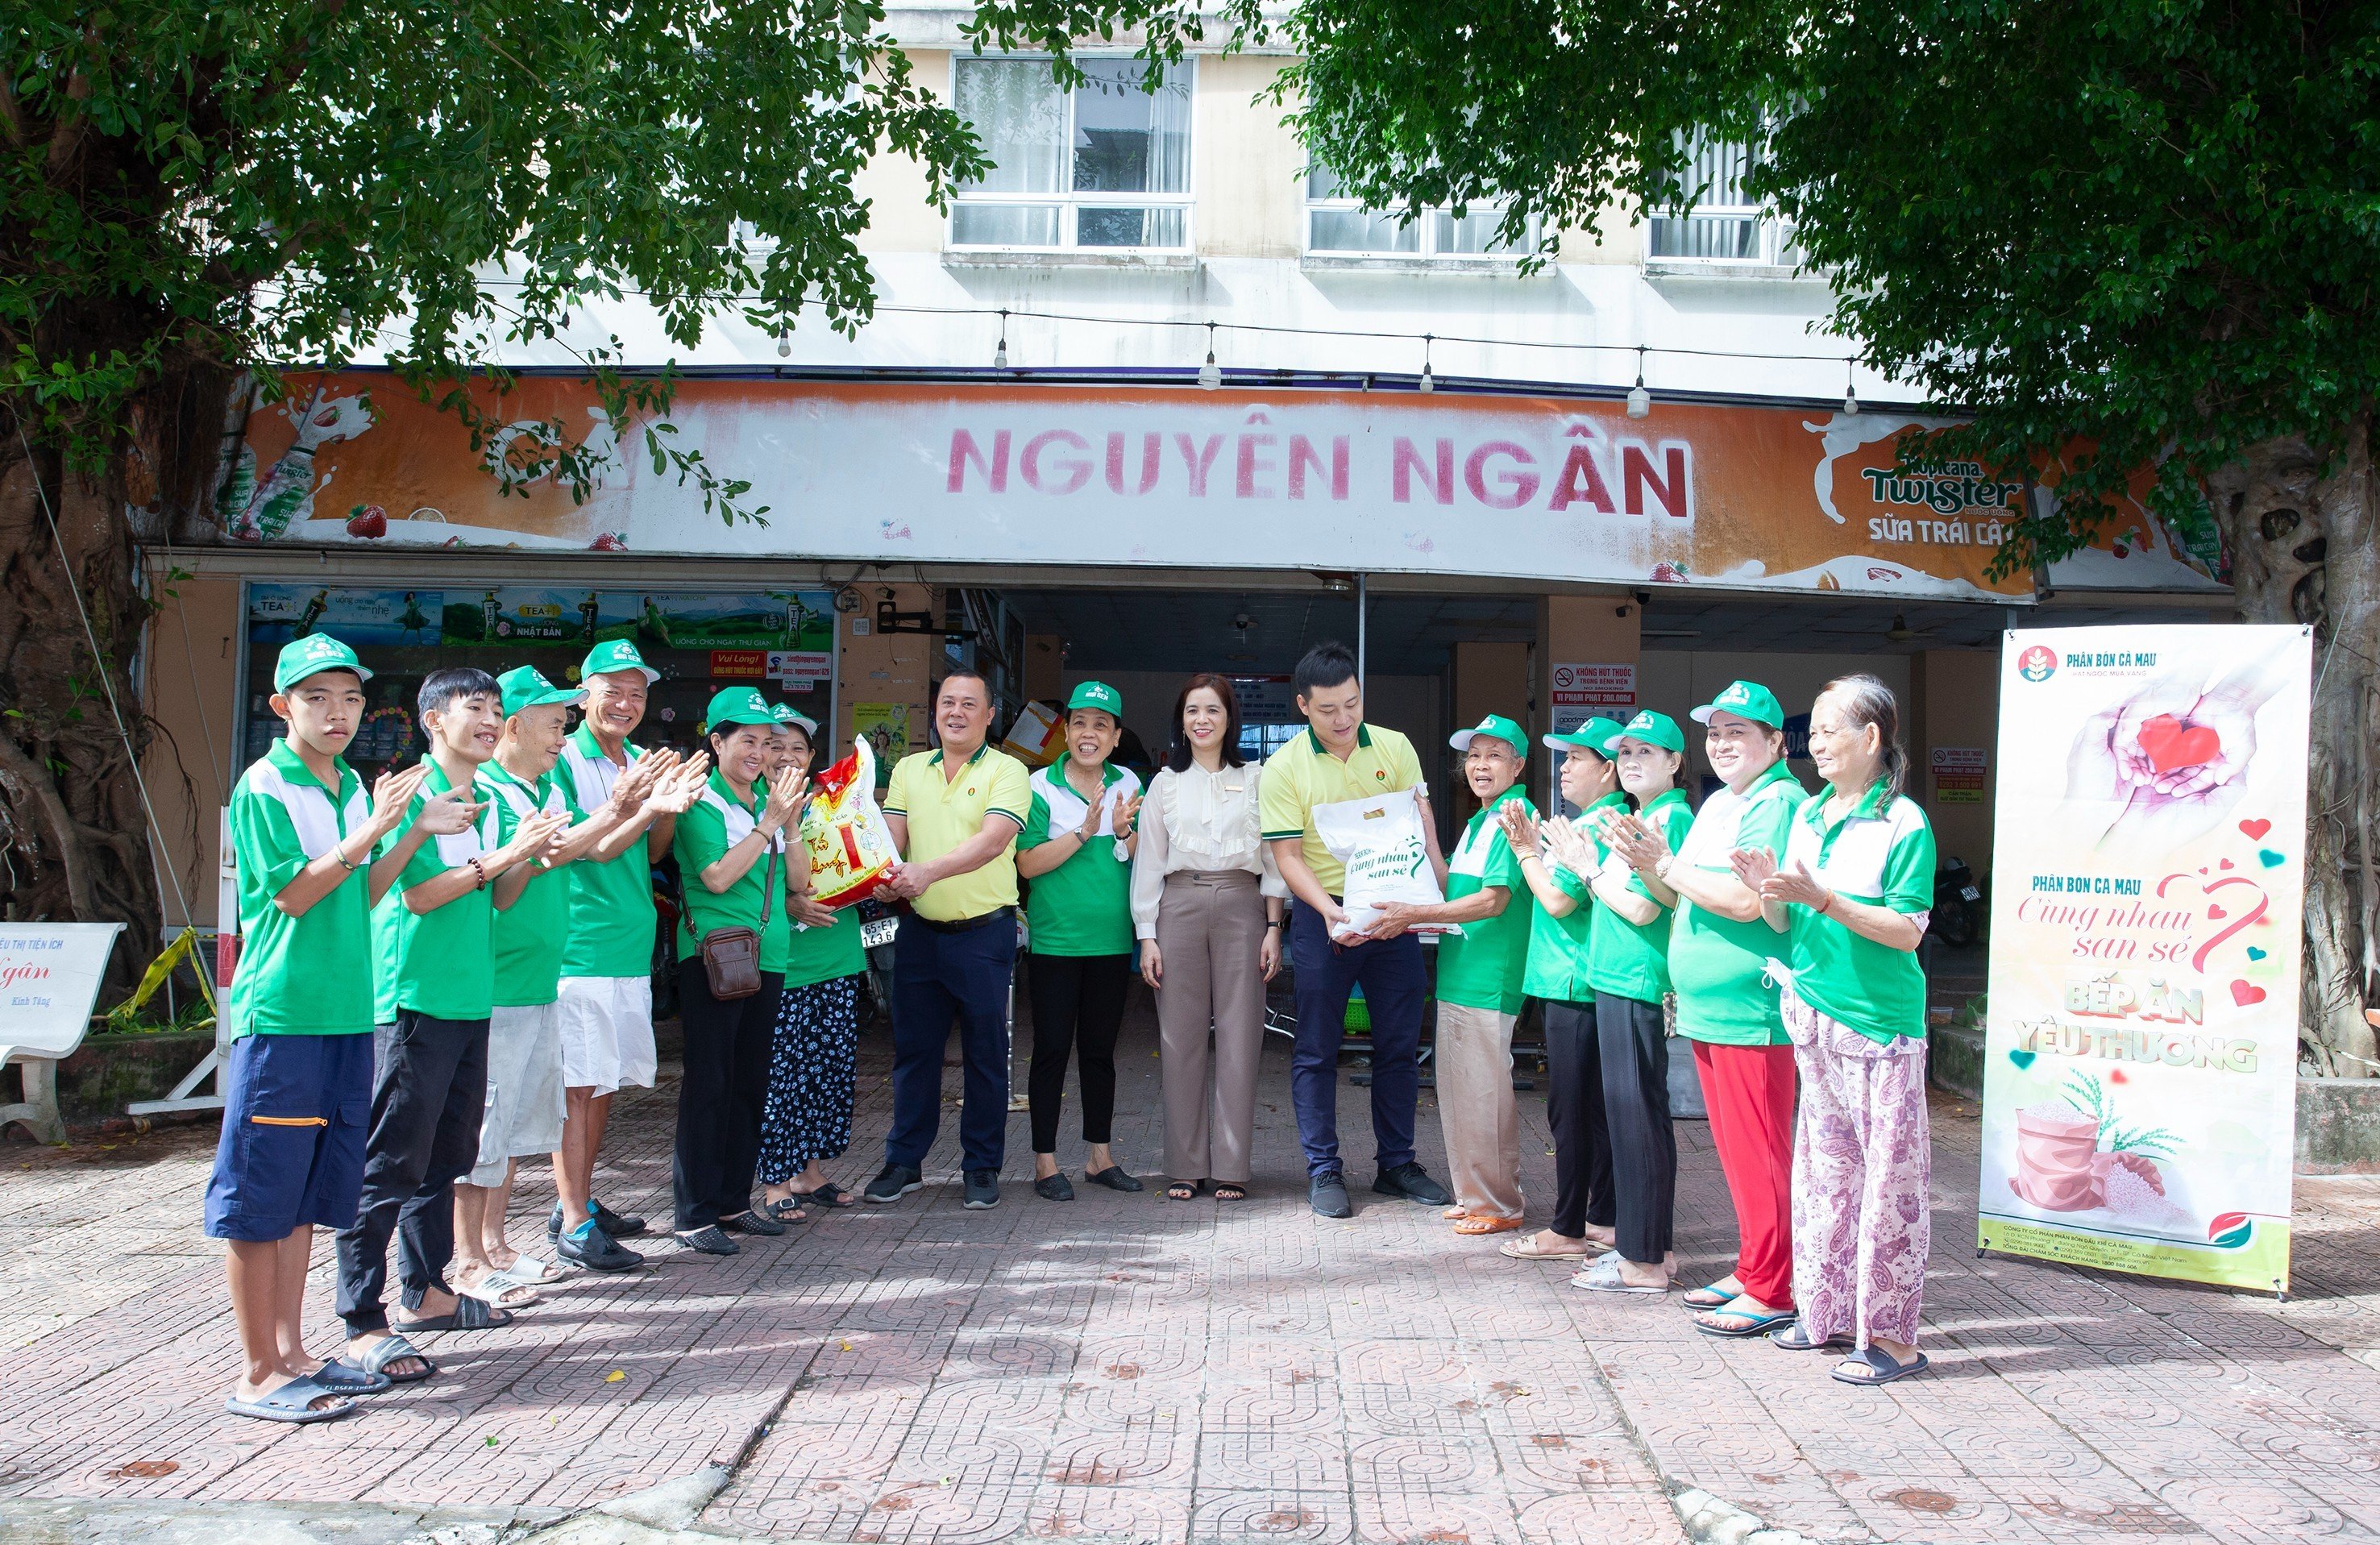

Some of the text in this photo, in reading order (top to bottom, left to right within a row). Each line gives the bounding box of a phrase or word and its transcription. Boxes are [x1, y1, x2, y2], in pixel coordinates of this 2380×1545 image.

[946, 410, 1687, 517] NGUYÊN NGÂN
[1861, 467, 2023, 515] Twister
[1868, 513, 1913, 542] SỮA
[1917, 517, 1971, 544] TRÁI
[335, 595, 353, 605] uống
[372, 605, 389, 617] nhẹ
[517, 626, 562, 638] NHẬT BẢN
[675, 637, 697, 645] UỐNG
[716, 638, 737, 646] NGÀY
[739, 638, 753, 646] THƯ
[718, 654, 733, 663] Vui
[2066, 650, 2157, 667] PHÂN BÓN CÀ MAU
[1576, 665, 1631, 677] KHÔNG HÚT THUỐC
[1599, 677, 1614, 685] BỆNH
[1556, 693, 1631, 704] VI PHẠM PHẠT 200.000đ
[1377, 852, 1408, 865] nhau
[1367, 868, 1389, 880] san
[2032, 874, 2063, 892] PHÂN
[2114, 878, 2141, 895] MAU
[2018, 895, 2193, 933] Cùng nhau
[865, 919, 893, 935] 65-E1
[12, 940, 27, 951] THỊ
[28, 937, 48, 951] TIỆN
[48, 938, 64, 949] ÍCH
[863, 931, 892, 947] 143.6
[2072, 936, 2139, 961] san
[11, 996, 52, 1008] Kính Tặng
[2064, 971, 2203, 1025] BẾP ĂN
[2012, 1014, 2257, 1073] YÊU THƯƠNG
[2003, 1225, 2021, 1233] CÔNG
[2054, 1231, 2071, 1241] PHÂN
[2108, 1240, 2118, 1248] CÀ
[2172, 1256, 2187, 1264] Nam
